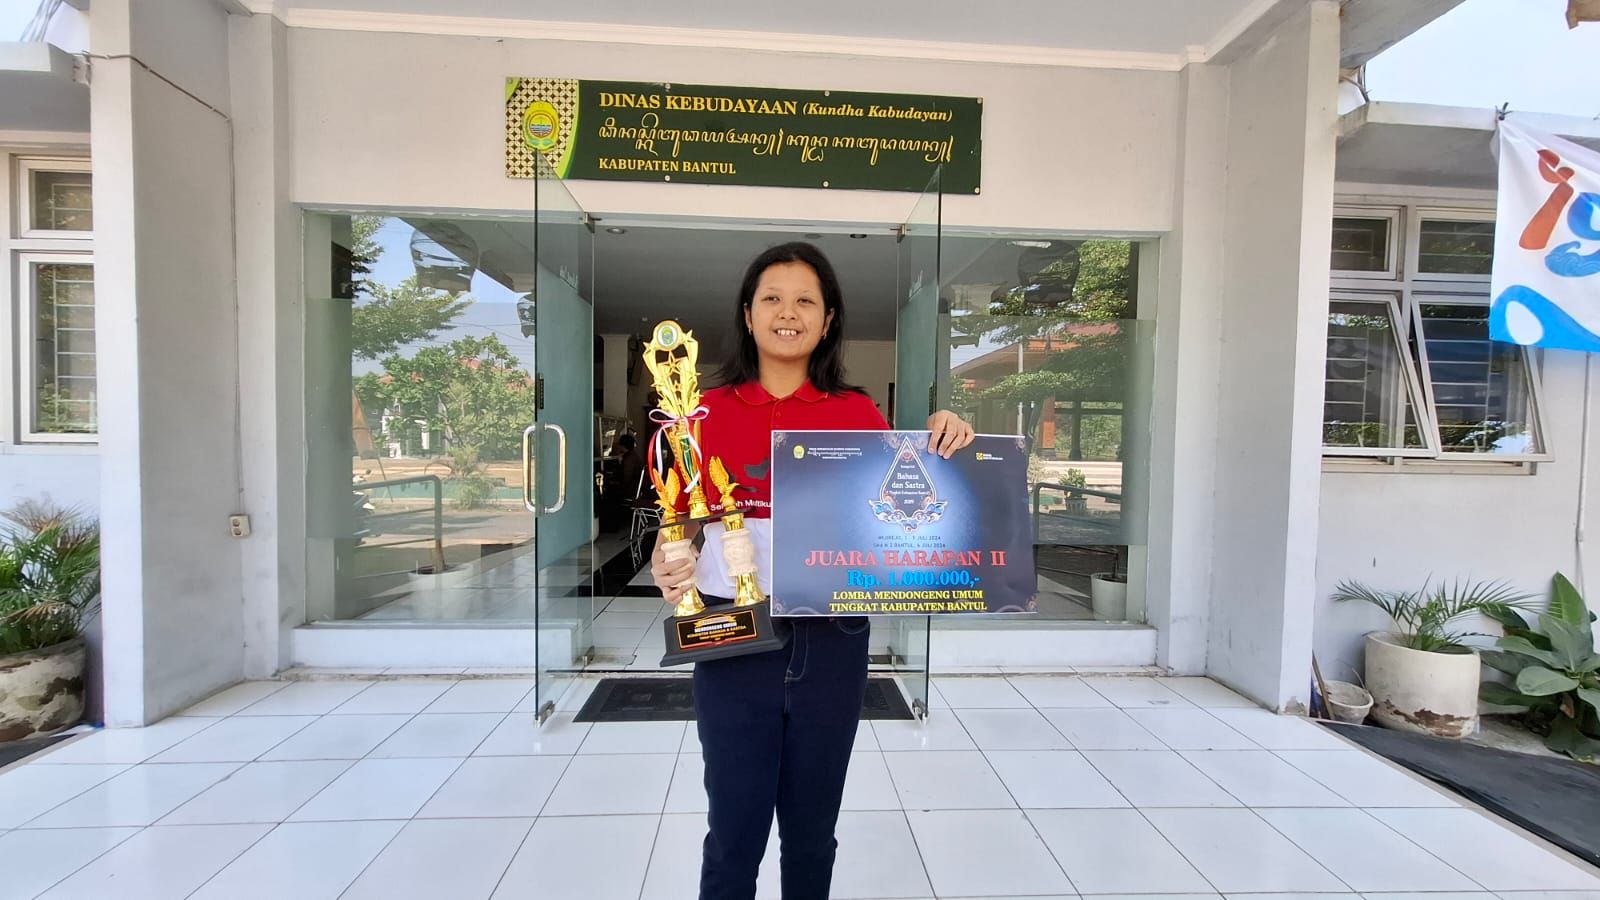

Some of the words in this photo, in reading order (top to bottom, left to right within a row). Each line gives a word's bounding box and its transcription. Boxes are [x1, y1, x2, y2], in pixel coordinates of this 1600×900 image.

[599, 92, 661, 109] DINAS
[665, 95, 797, 114] KEBUDAYAAN
[803, 102, 865, 117] (Kundha
[868, 105, 953, 122] Kabudayan)
[599, 158, 679, 172] KABUPATEN
[682, 161, 736, 174] BANTUL
[805, 550, 878, 567] JUARA
[883, 550, 980, 567] HARAPAN
[991, 550, 1006, 566] II
[848, 569, 881, 588] Rp.
[887, 570, 981, 588] 1.000.000,-
[833, 592, 871, 600] LOMBA
[874, 591, 950, 600] MENDONGENG
[952, 591, 983, 599] UMUM
[829, 603, 878, 612] TINGKAT
[881, 603, 945, 612] KABUPATEN
[947, 602, 987, 611] BANTUL
